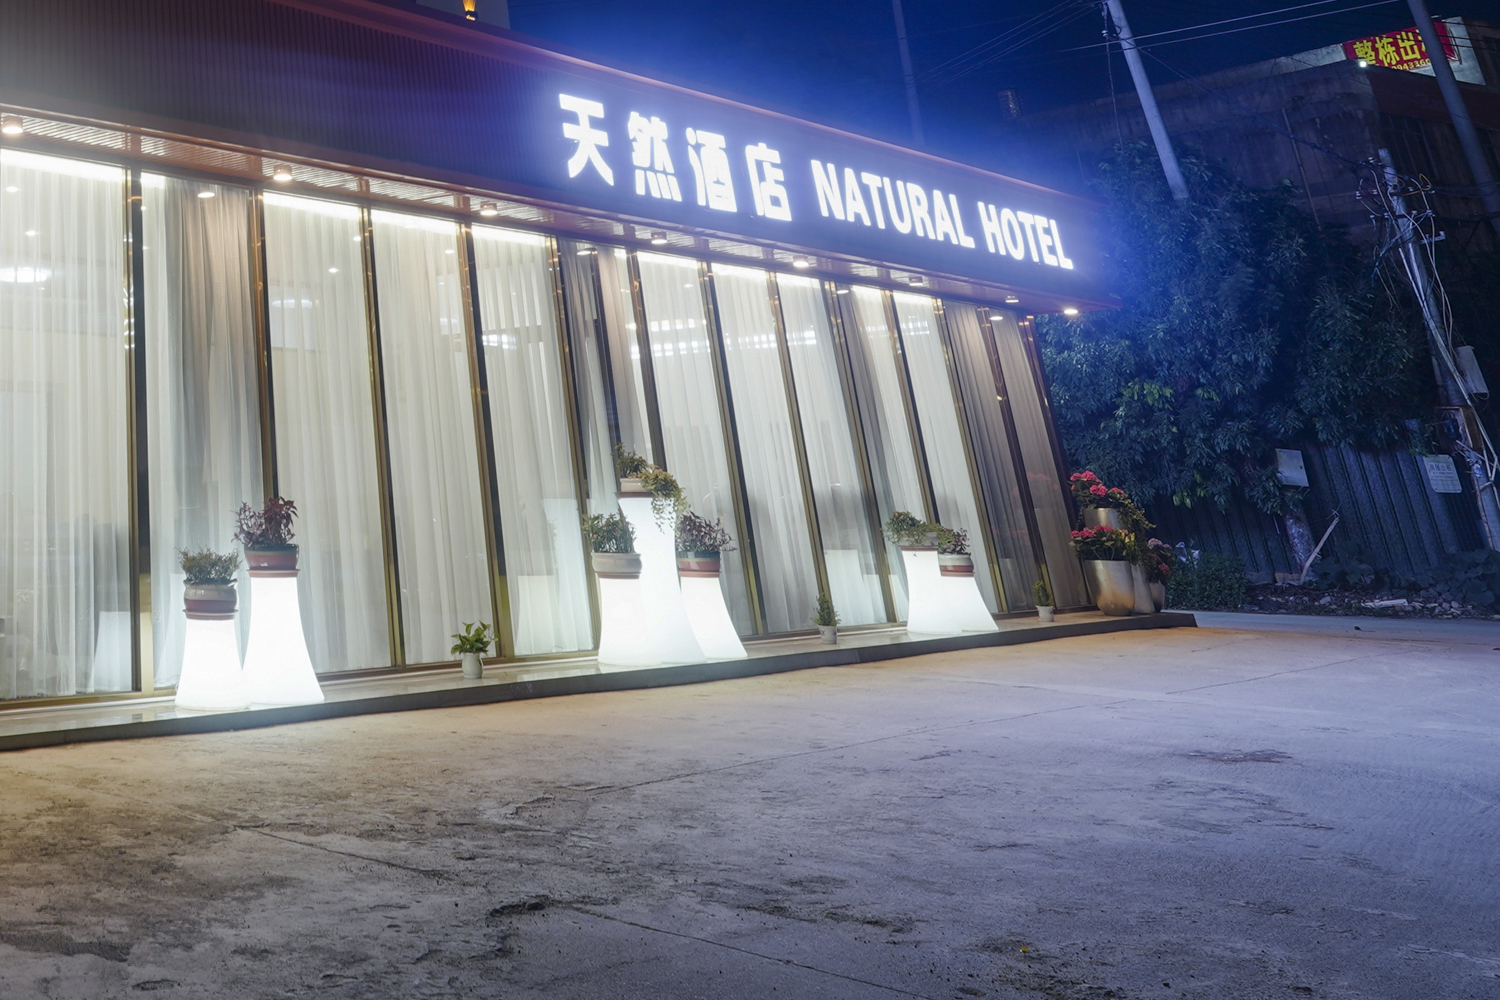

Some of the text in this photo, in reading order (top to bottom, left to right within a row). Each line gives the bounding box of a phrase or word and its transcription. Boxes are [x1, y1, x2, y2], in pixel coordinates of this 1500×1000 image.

[1353, 29, 1426, 67] 整栋出
[559, 93, 1074, 270] 天然酒店 NATURAL HOTEL
